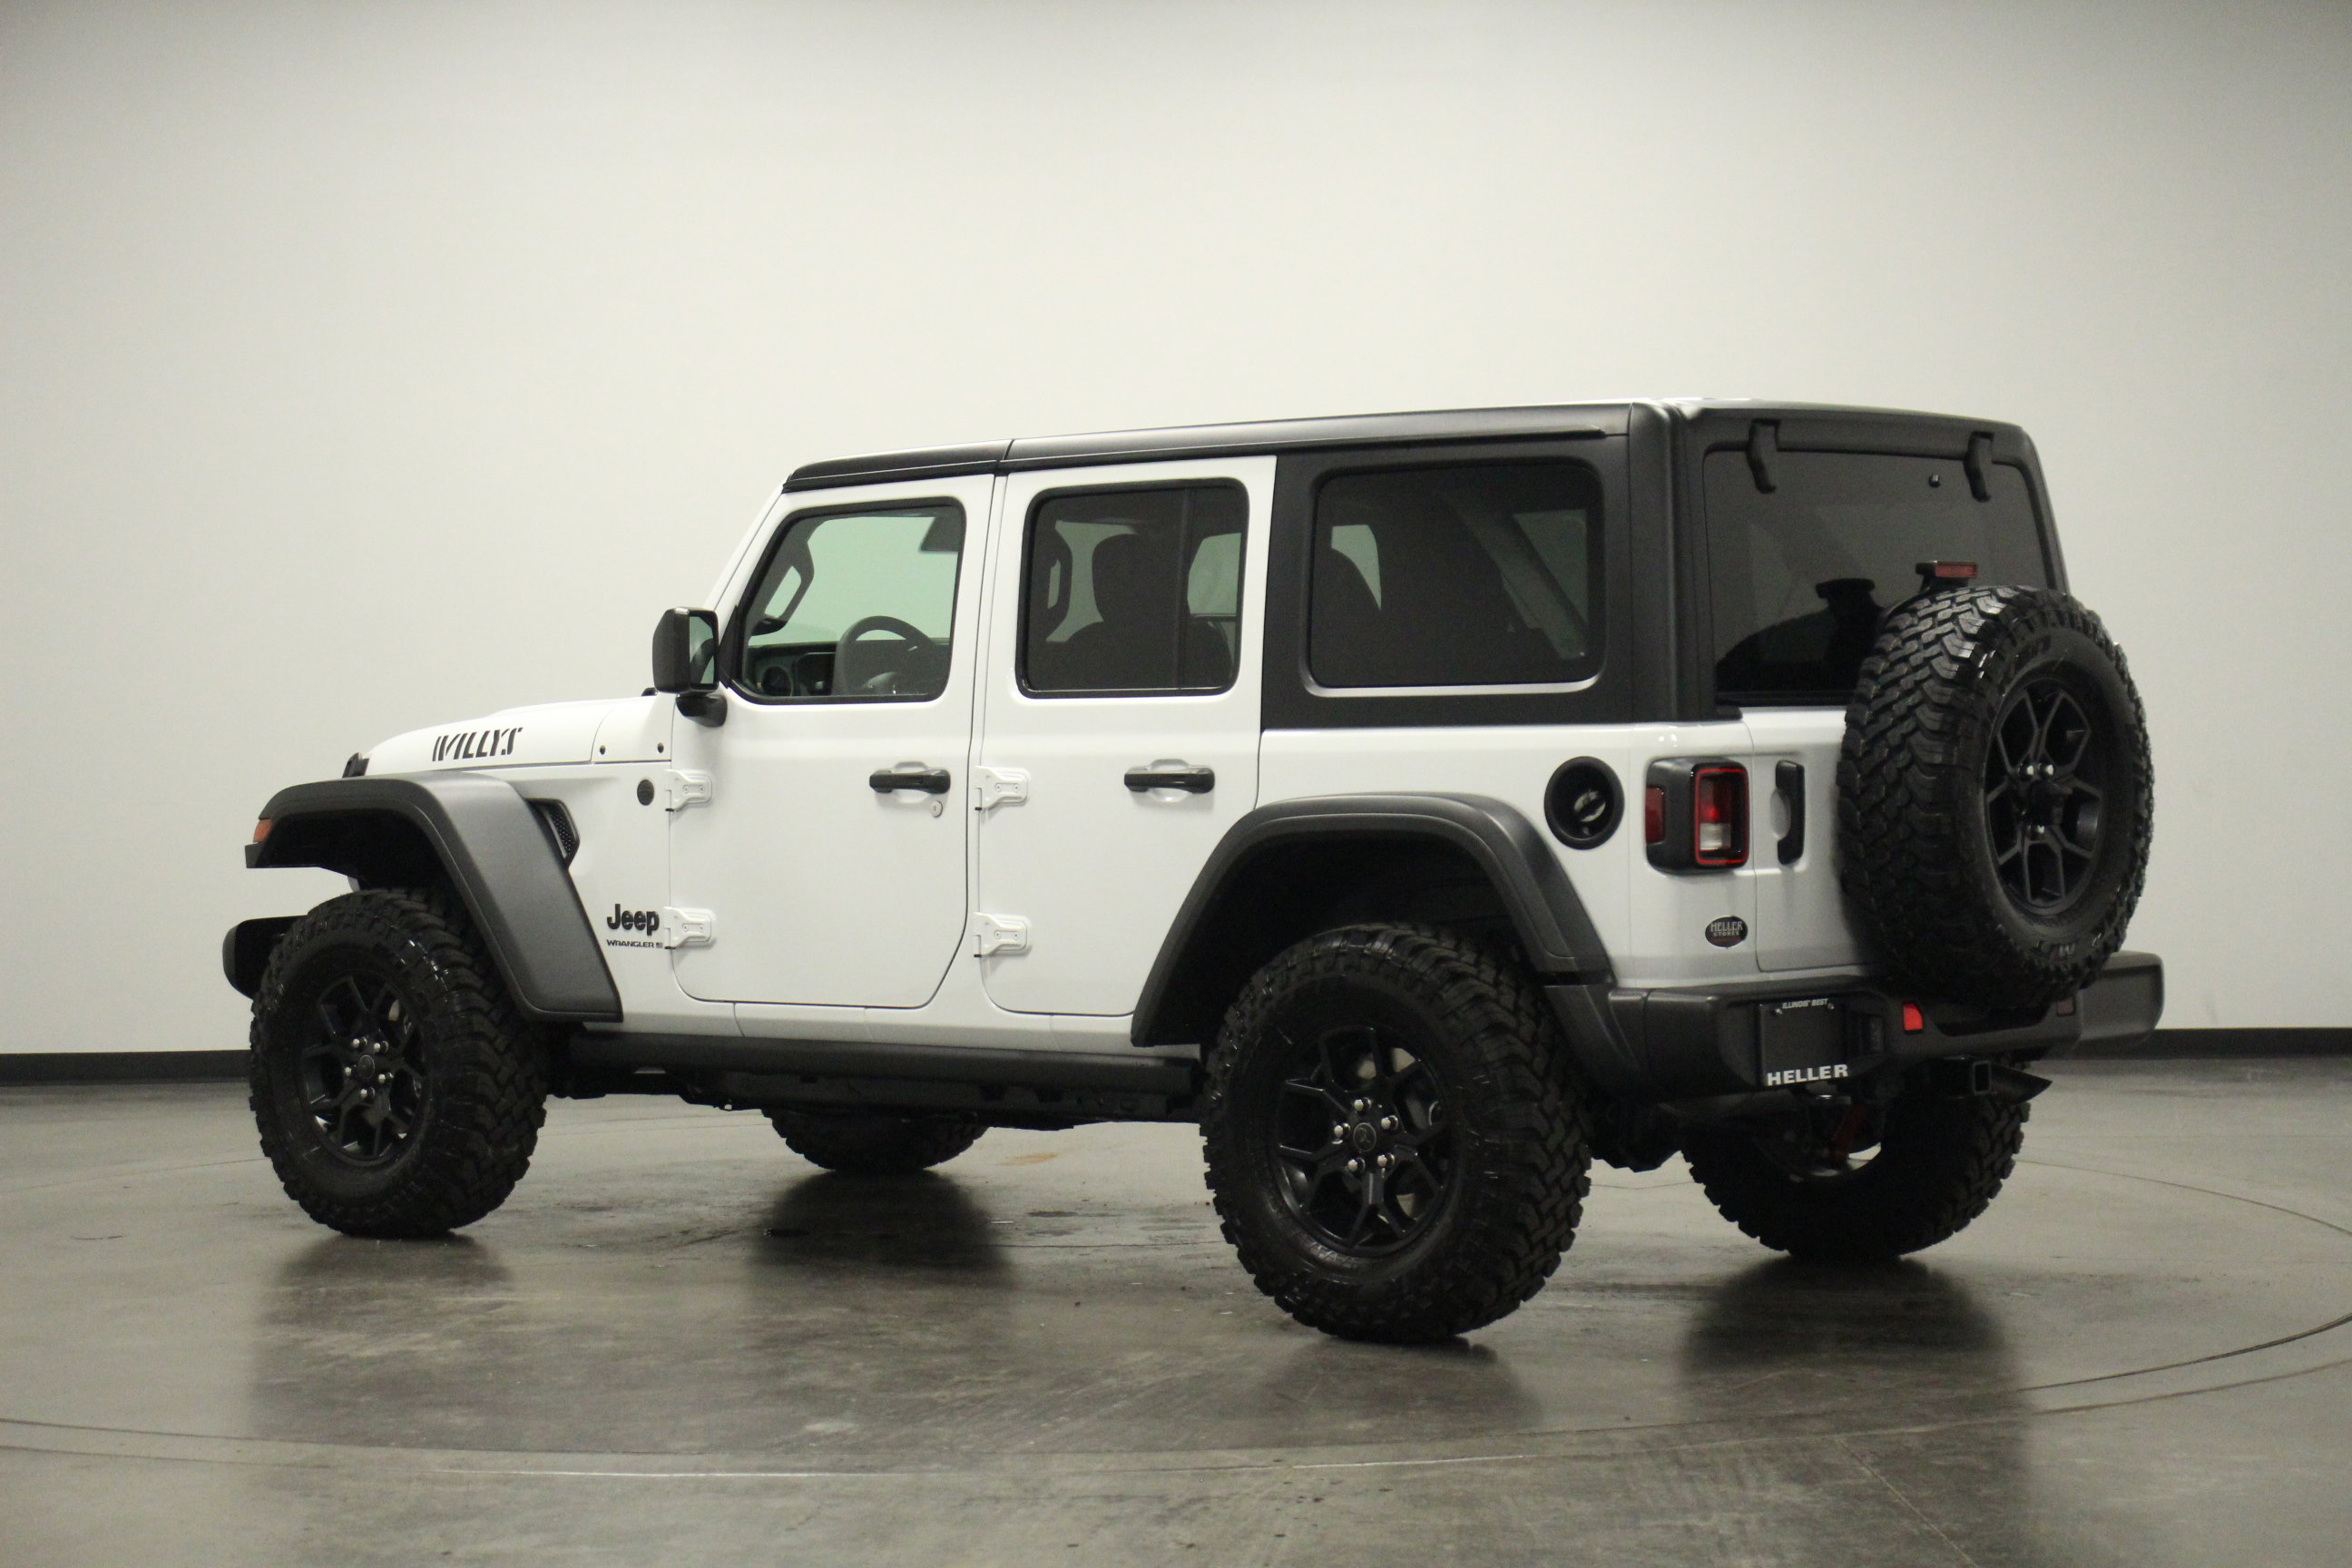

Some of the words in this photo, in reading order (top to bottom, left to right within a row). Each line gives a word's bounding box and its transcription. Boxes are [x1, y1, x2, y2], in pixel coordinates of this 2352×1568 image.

[432, 727, 523, 761] WILLYS
[606, 904, 660, 936] Jeep
[1710, 921, 1743, 932] HELLER
[606, 939, 654, 948] WRANGLER
[1811, 998, 1828, 1006] BEST
[1767, 1064, 1848, 1086] HELLER
